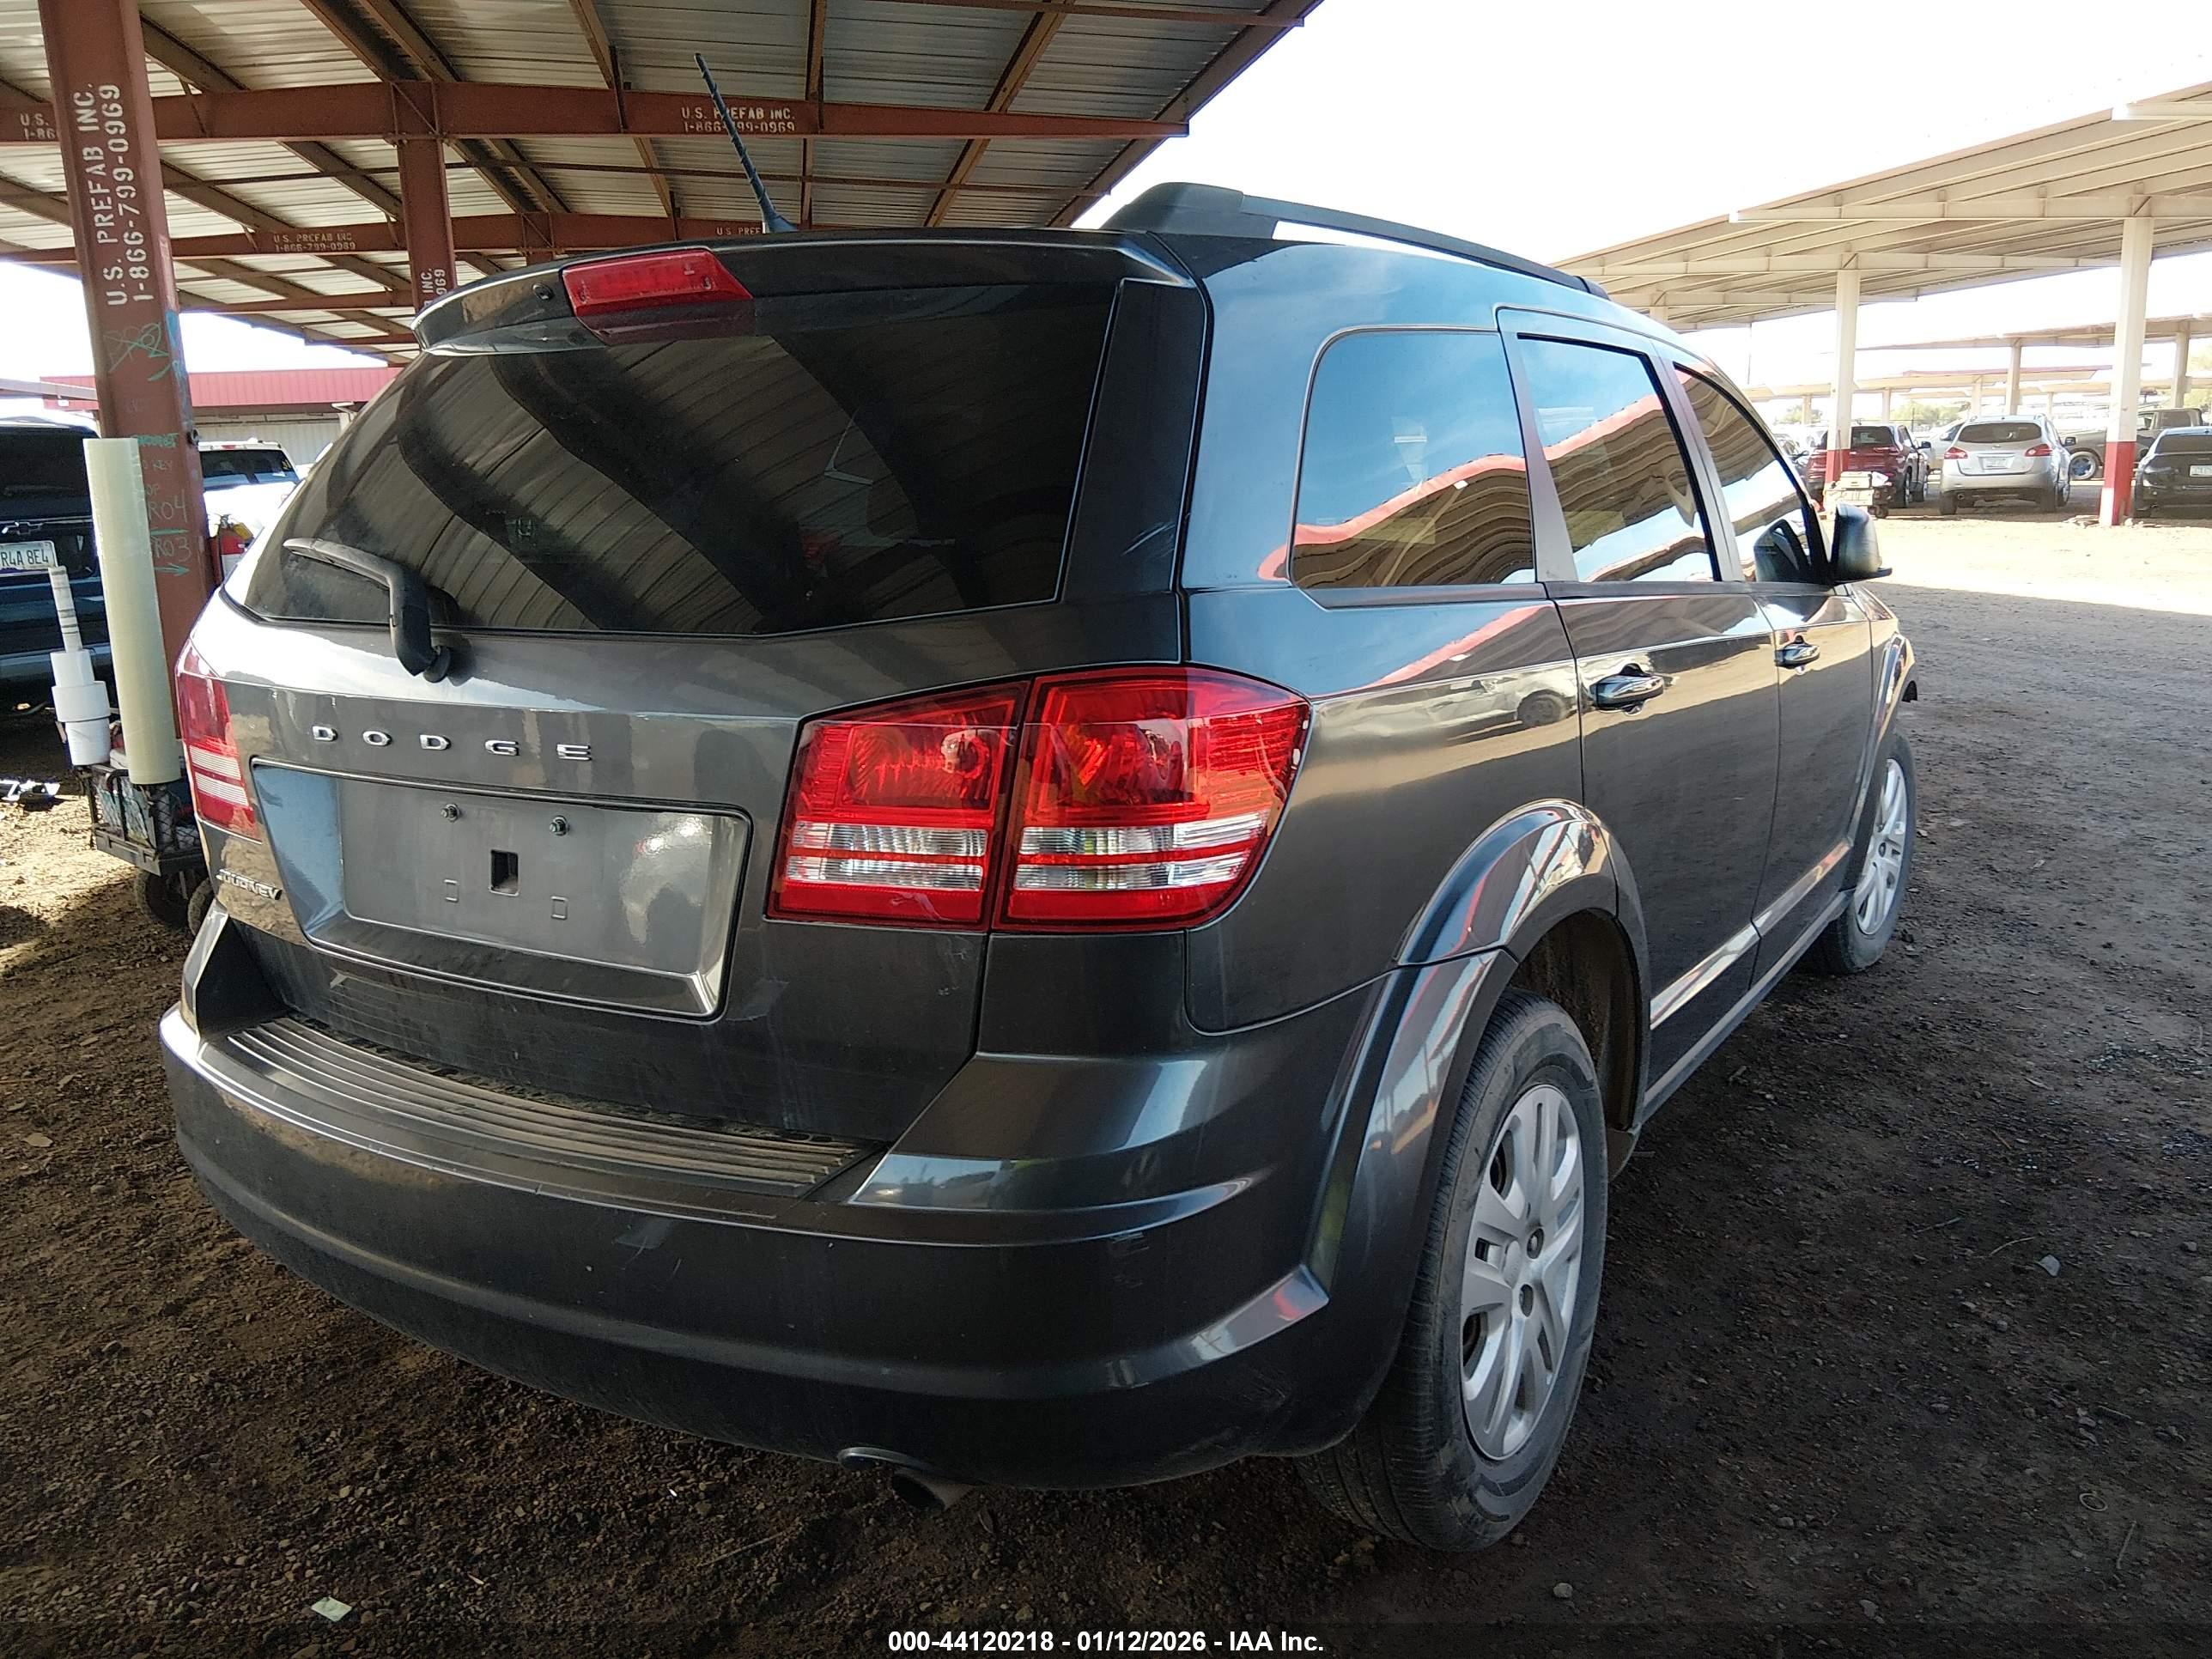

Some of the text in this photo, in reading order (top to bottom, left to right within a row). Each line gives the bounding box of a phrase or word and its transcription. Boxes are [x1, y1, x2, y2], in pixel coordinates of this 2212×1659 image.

[681, 106, 795, 119] U.S. PEFAB INC.
[23, 127, 56, 140] 1-86
[684, 121, 795, 133] 1-866-99-0969
[73, 83, 128, 306] U.S. PREFAB INC.
[98, 84, 154, 301] 1-866-799-0969
[421, 268, 434, 293] INC.
[434, 269, 447, 295] 969
[312, 726, 592, 762] DODGE
[216, 868, 283, 900] JOURNEY
